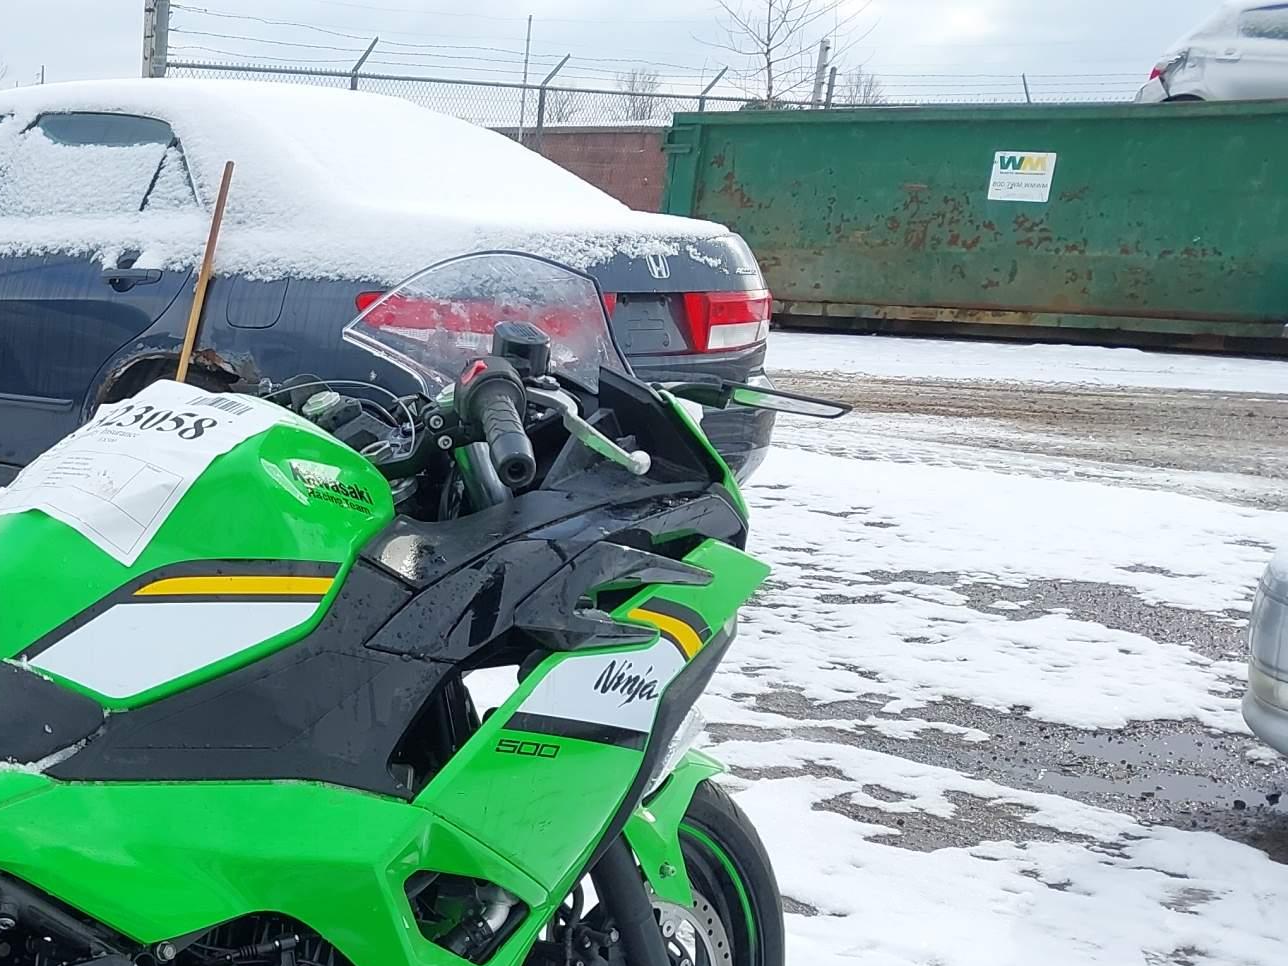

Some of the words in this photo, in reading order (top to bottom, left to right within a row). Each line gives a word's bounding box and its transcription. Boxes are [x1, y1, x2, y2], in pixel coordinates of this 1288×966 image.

[999, 155, 1048, 171] WM
[594, 659, 659, 708] Ninja
[495, 738, 561, 759] 500
